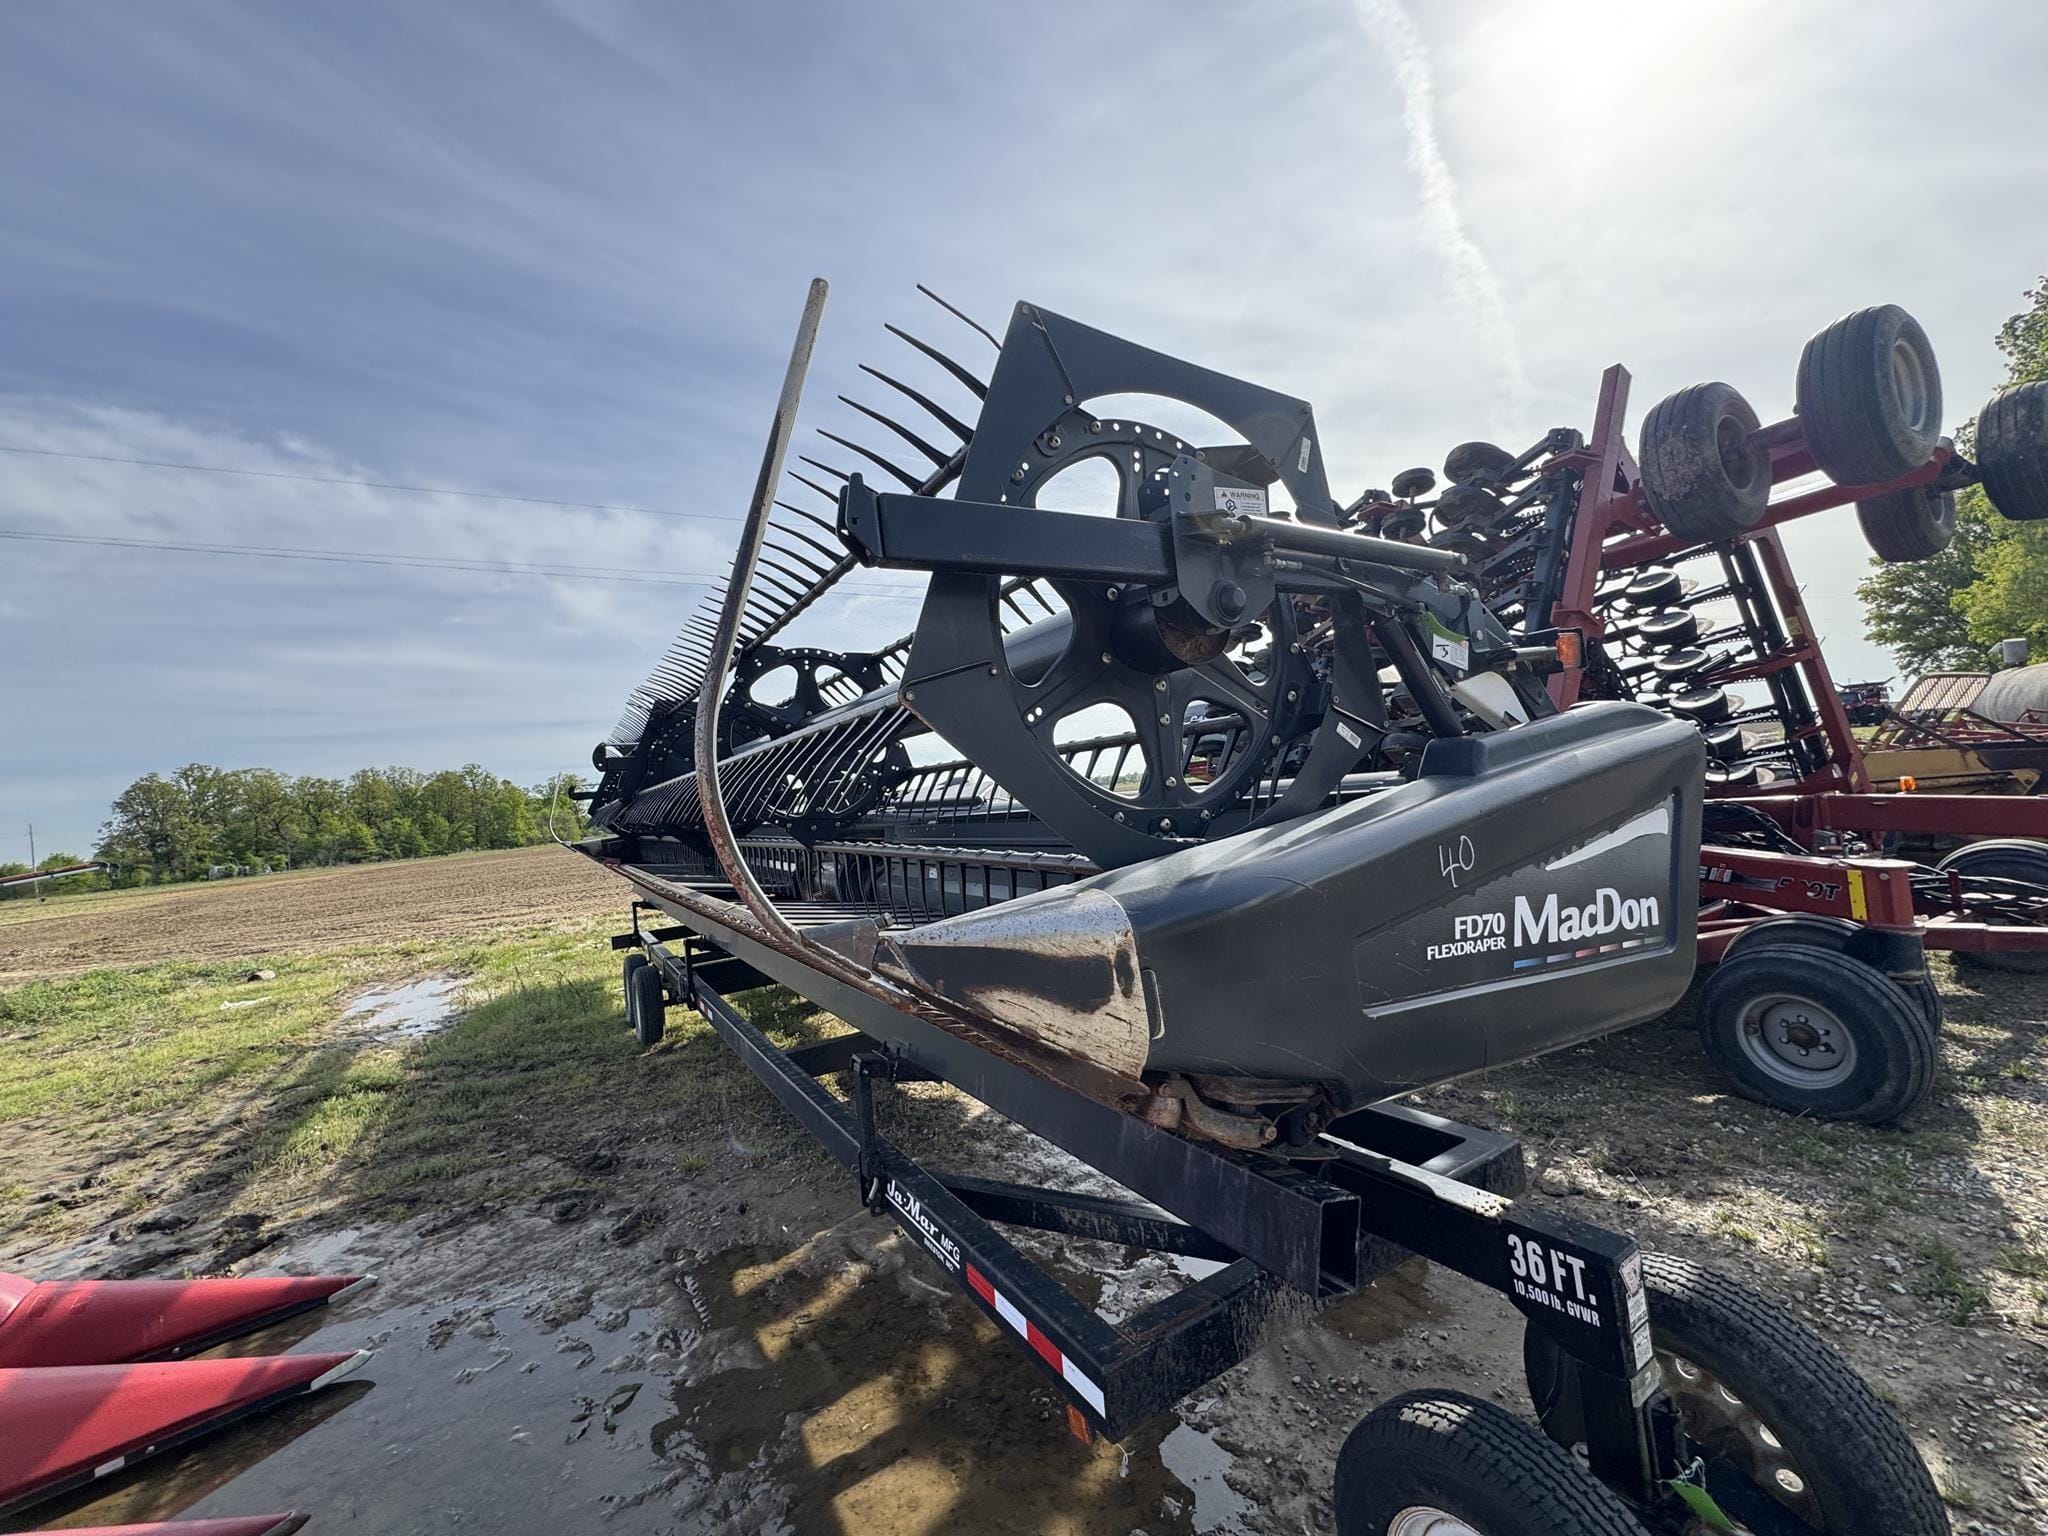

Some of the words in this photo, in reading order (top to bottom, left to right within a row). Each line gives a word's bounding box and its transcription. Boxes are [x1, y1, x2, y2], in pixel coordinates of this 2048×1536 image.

[1229, 491, 1260, 500] WARNING
[1438, 835, 1475, 888] 40
[1454, 912, 1505, 940] FD70
[1513, 887, 1660, 947] MacDon
[1426, 936, 1506, 960] FLEXDRAPER
[940, 1233, 960, 1262] MFG
[1507, 1233, 1546, 1285] 36
[1549, 1248, 1597, 1306] FT.
[1513, 1278, 1549, 1306] 10,500
[1549, 1293, 1565, 1312] lb.
[1566, 1300, 1601, 1328] GVWR
